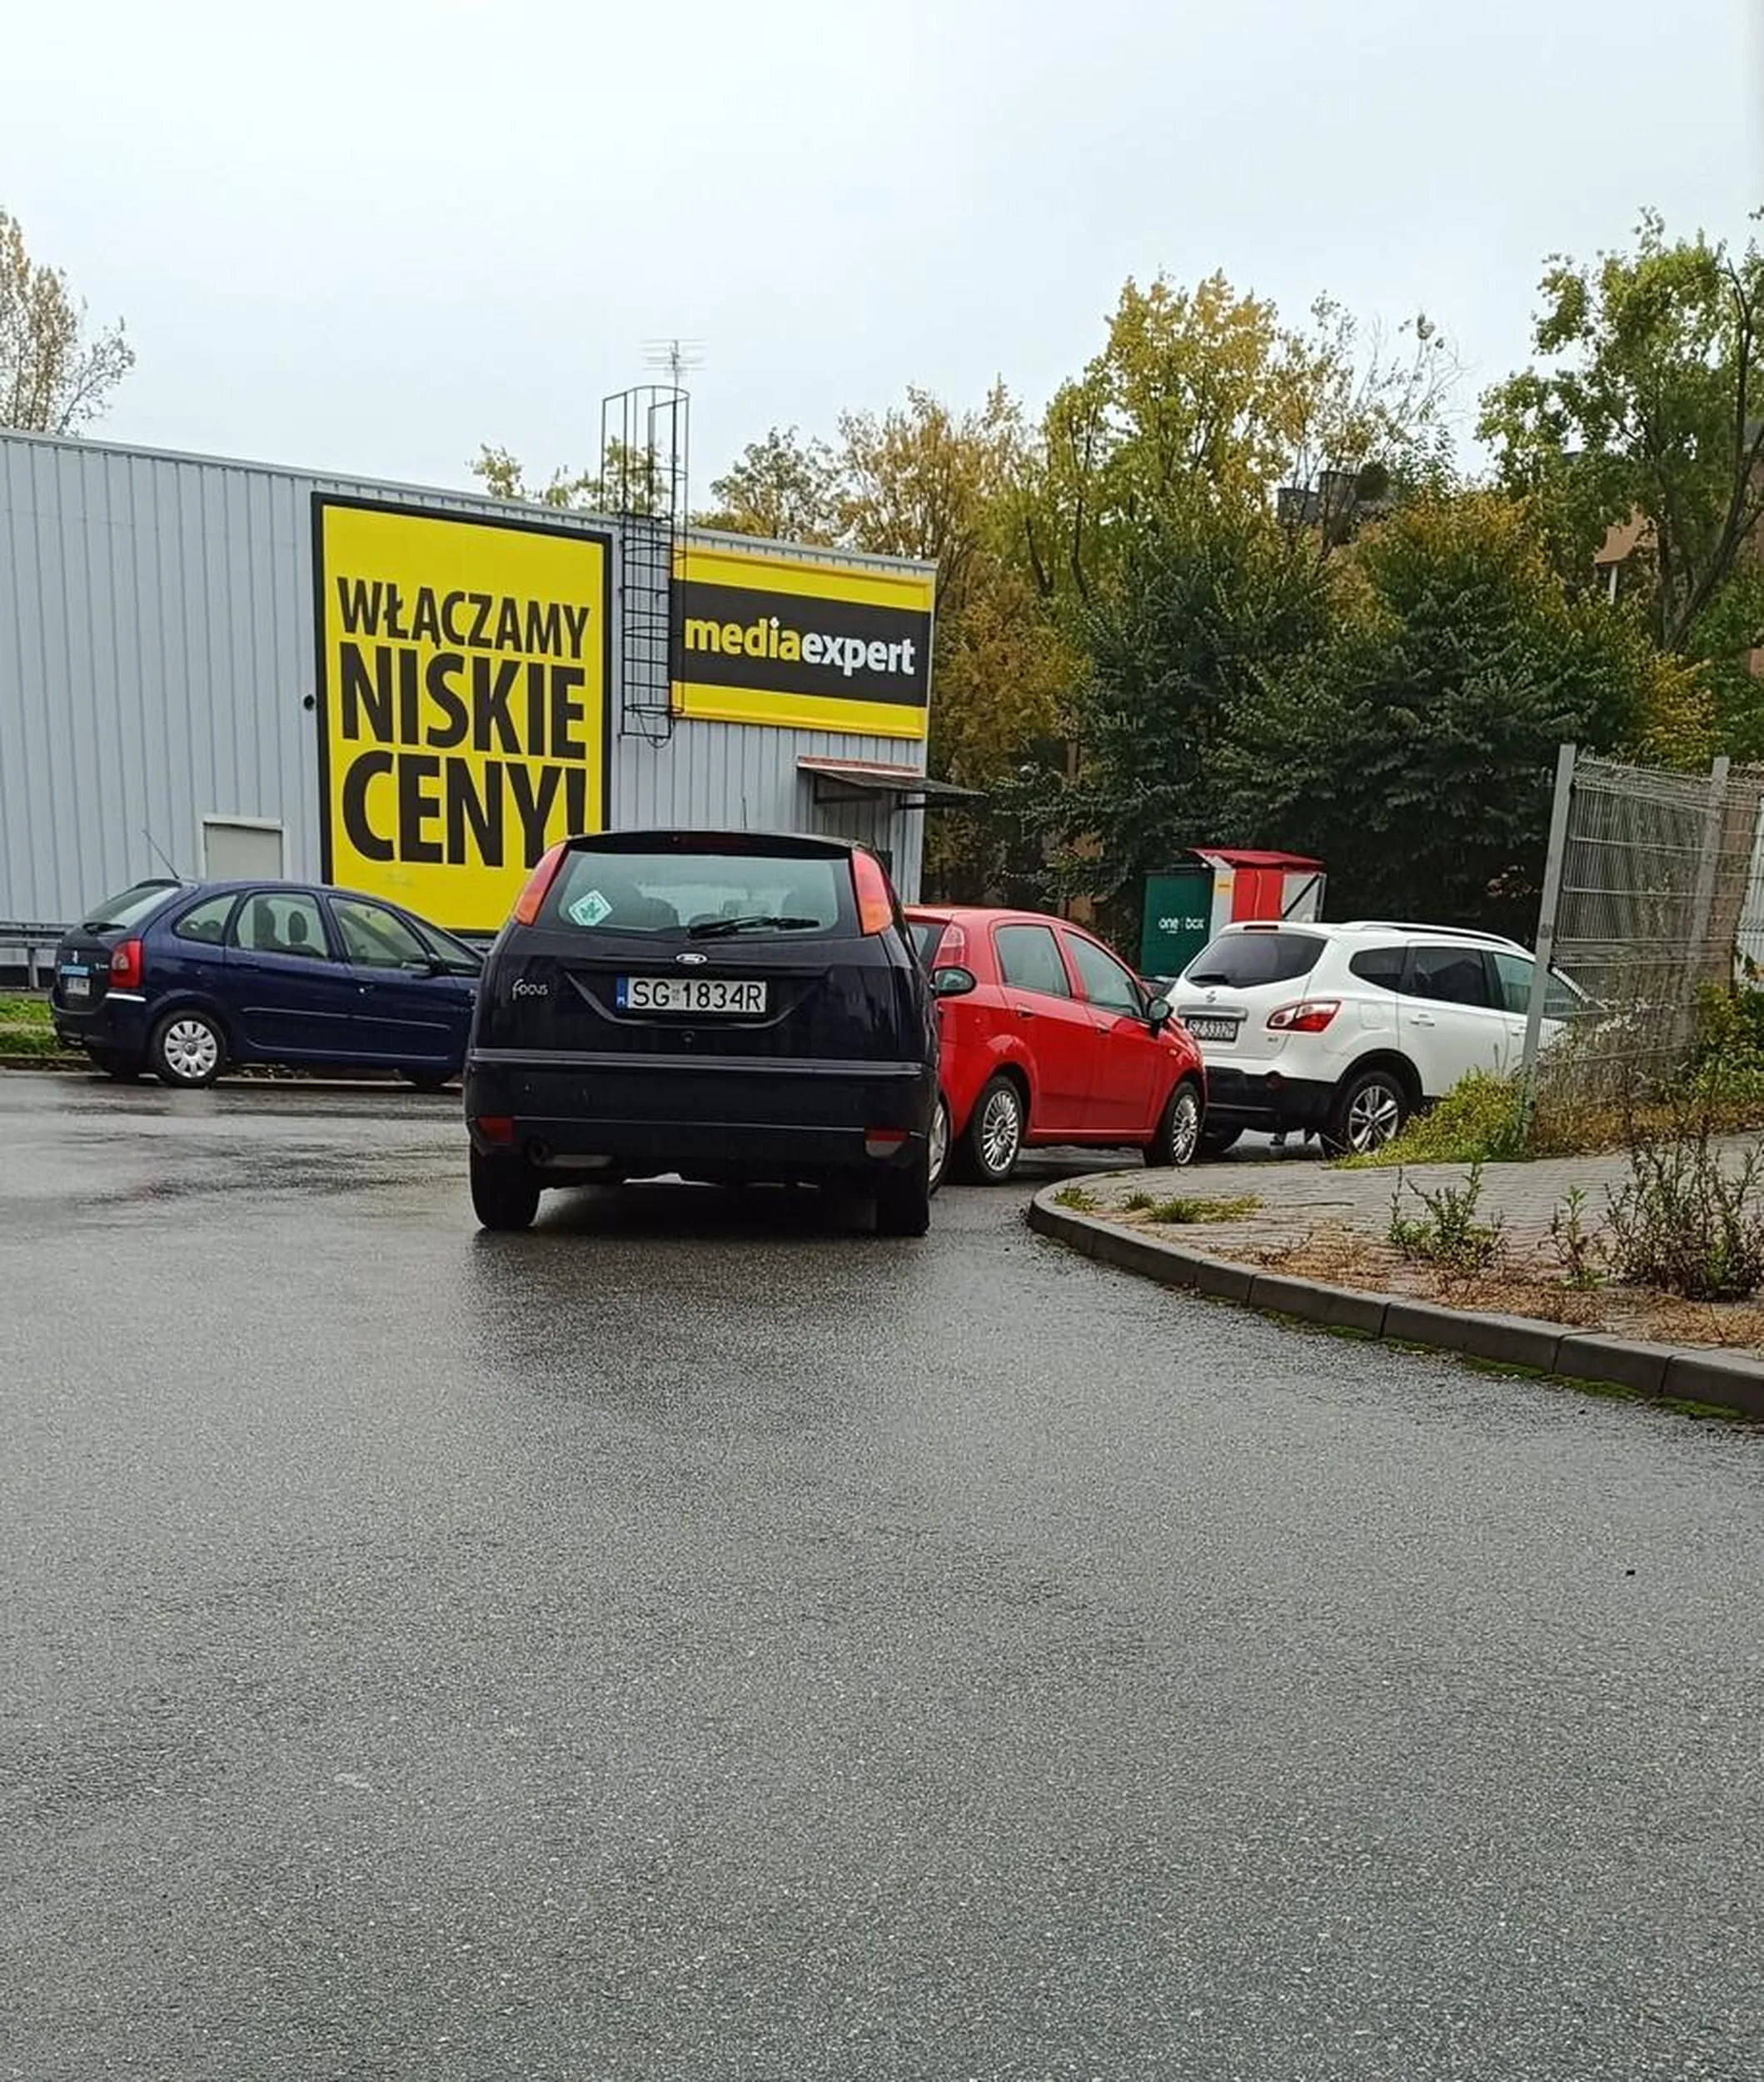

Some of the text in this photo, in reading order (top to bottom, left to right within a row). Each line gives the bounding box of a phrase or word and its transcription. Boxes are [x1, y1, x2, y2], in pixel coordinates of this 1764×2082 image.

[336, 576, 590, 659] WŁĄCZAMY
[339, 640, 586, 760] NISKIE
[342, 750, 586, 869] CENY!
[633, 980, 761, 1010] SG 1834R
